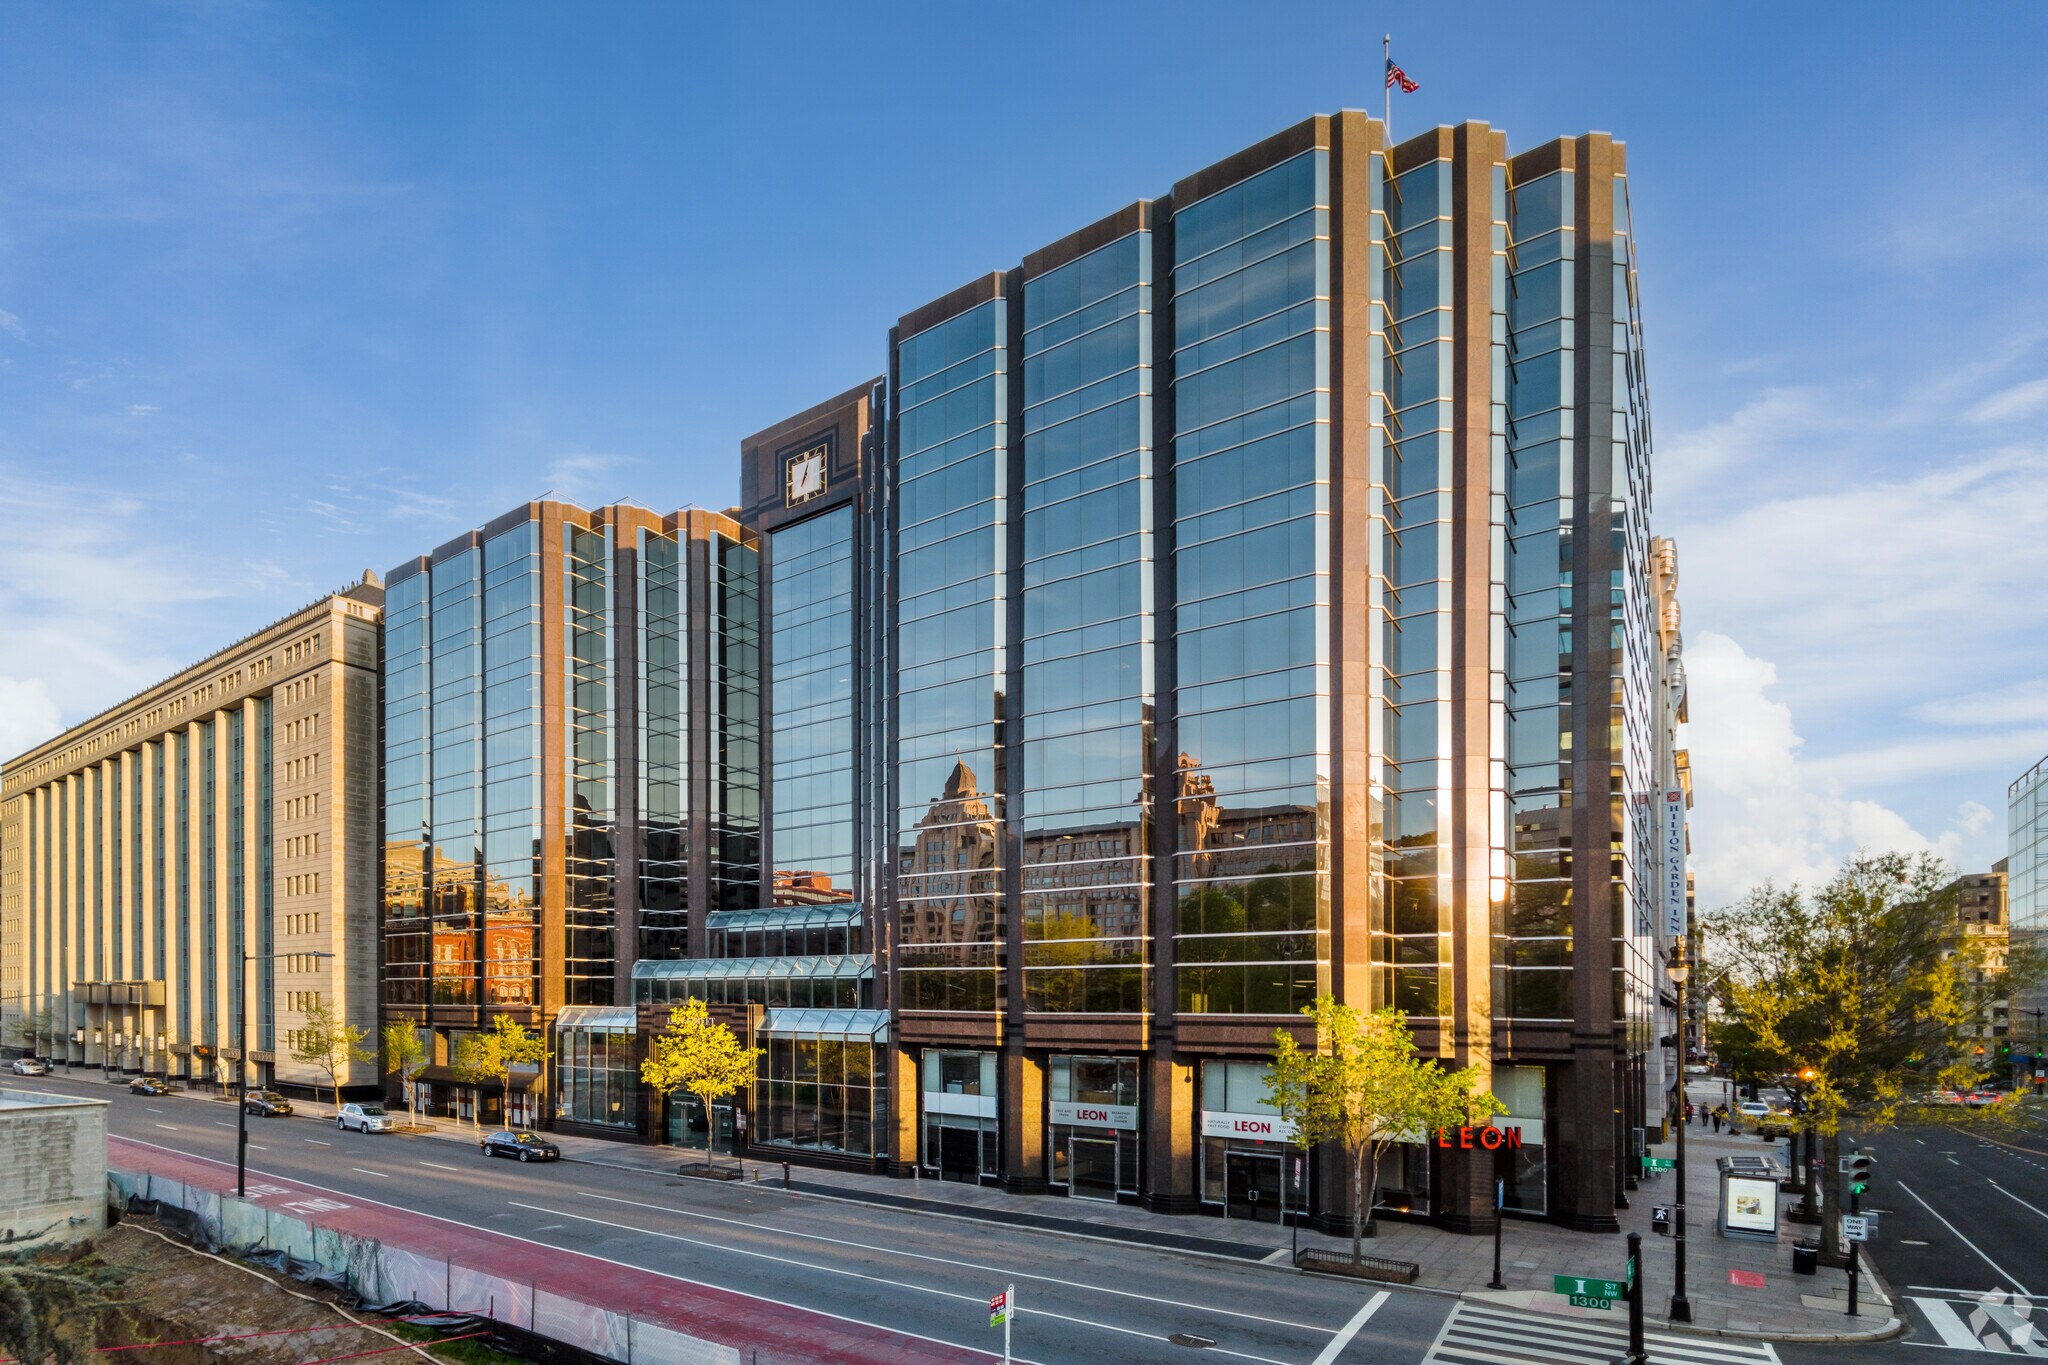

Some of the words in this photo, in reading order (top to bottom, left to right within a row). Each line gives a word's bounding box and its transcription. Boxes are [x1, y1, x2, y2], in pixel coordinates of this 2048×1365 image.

[1669, 804, 1680, 853] HILTON
[1669, 856, 1680, 905] GARDEN
[1670, 909, 1681, 932] INN
[1077, 1109, 1107, 1121] LEON
[1234, 1120, 1271, 1134] LEON
[1439, 1126, 1521, 1149] LEON
[1575, 1280, 1587, 1294] I
[1571, 1296, 1610, 1309] 1300
